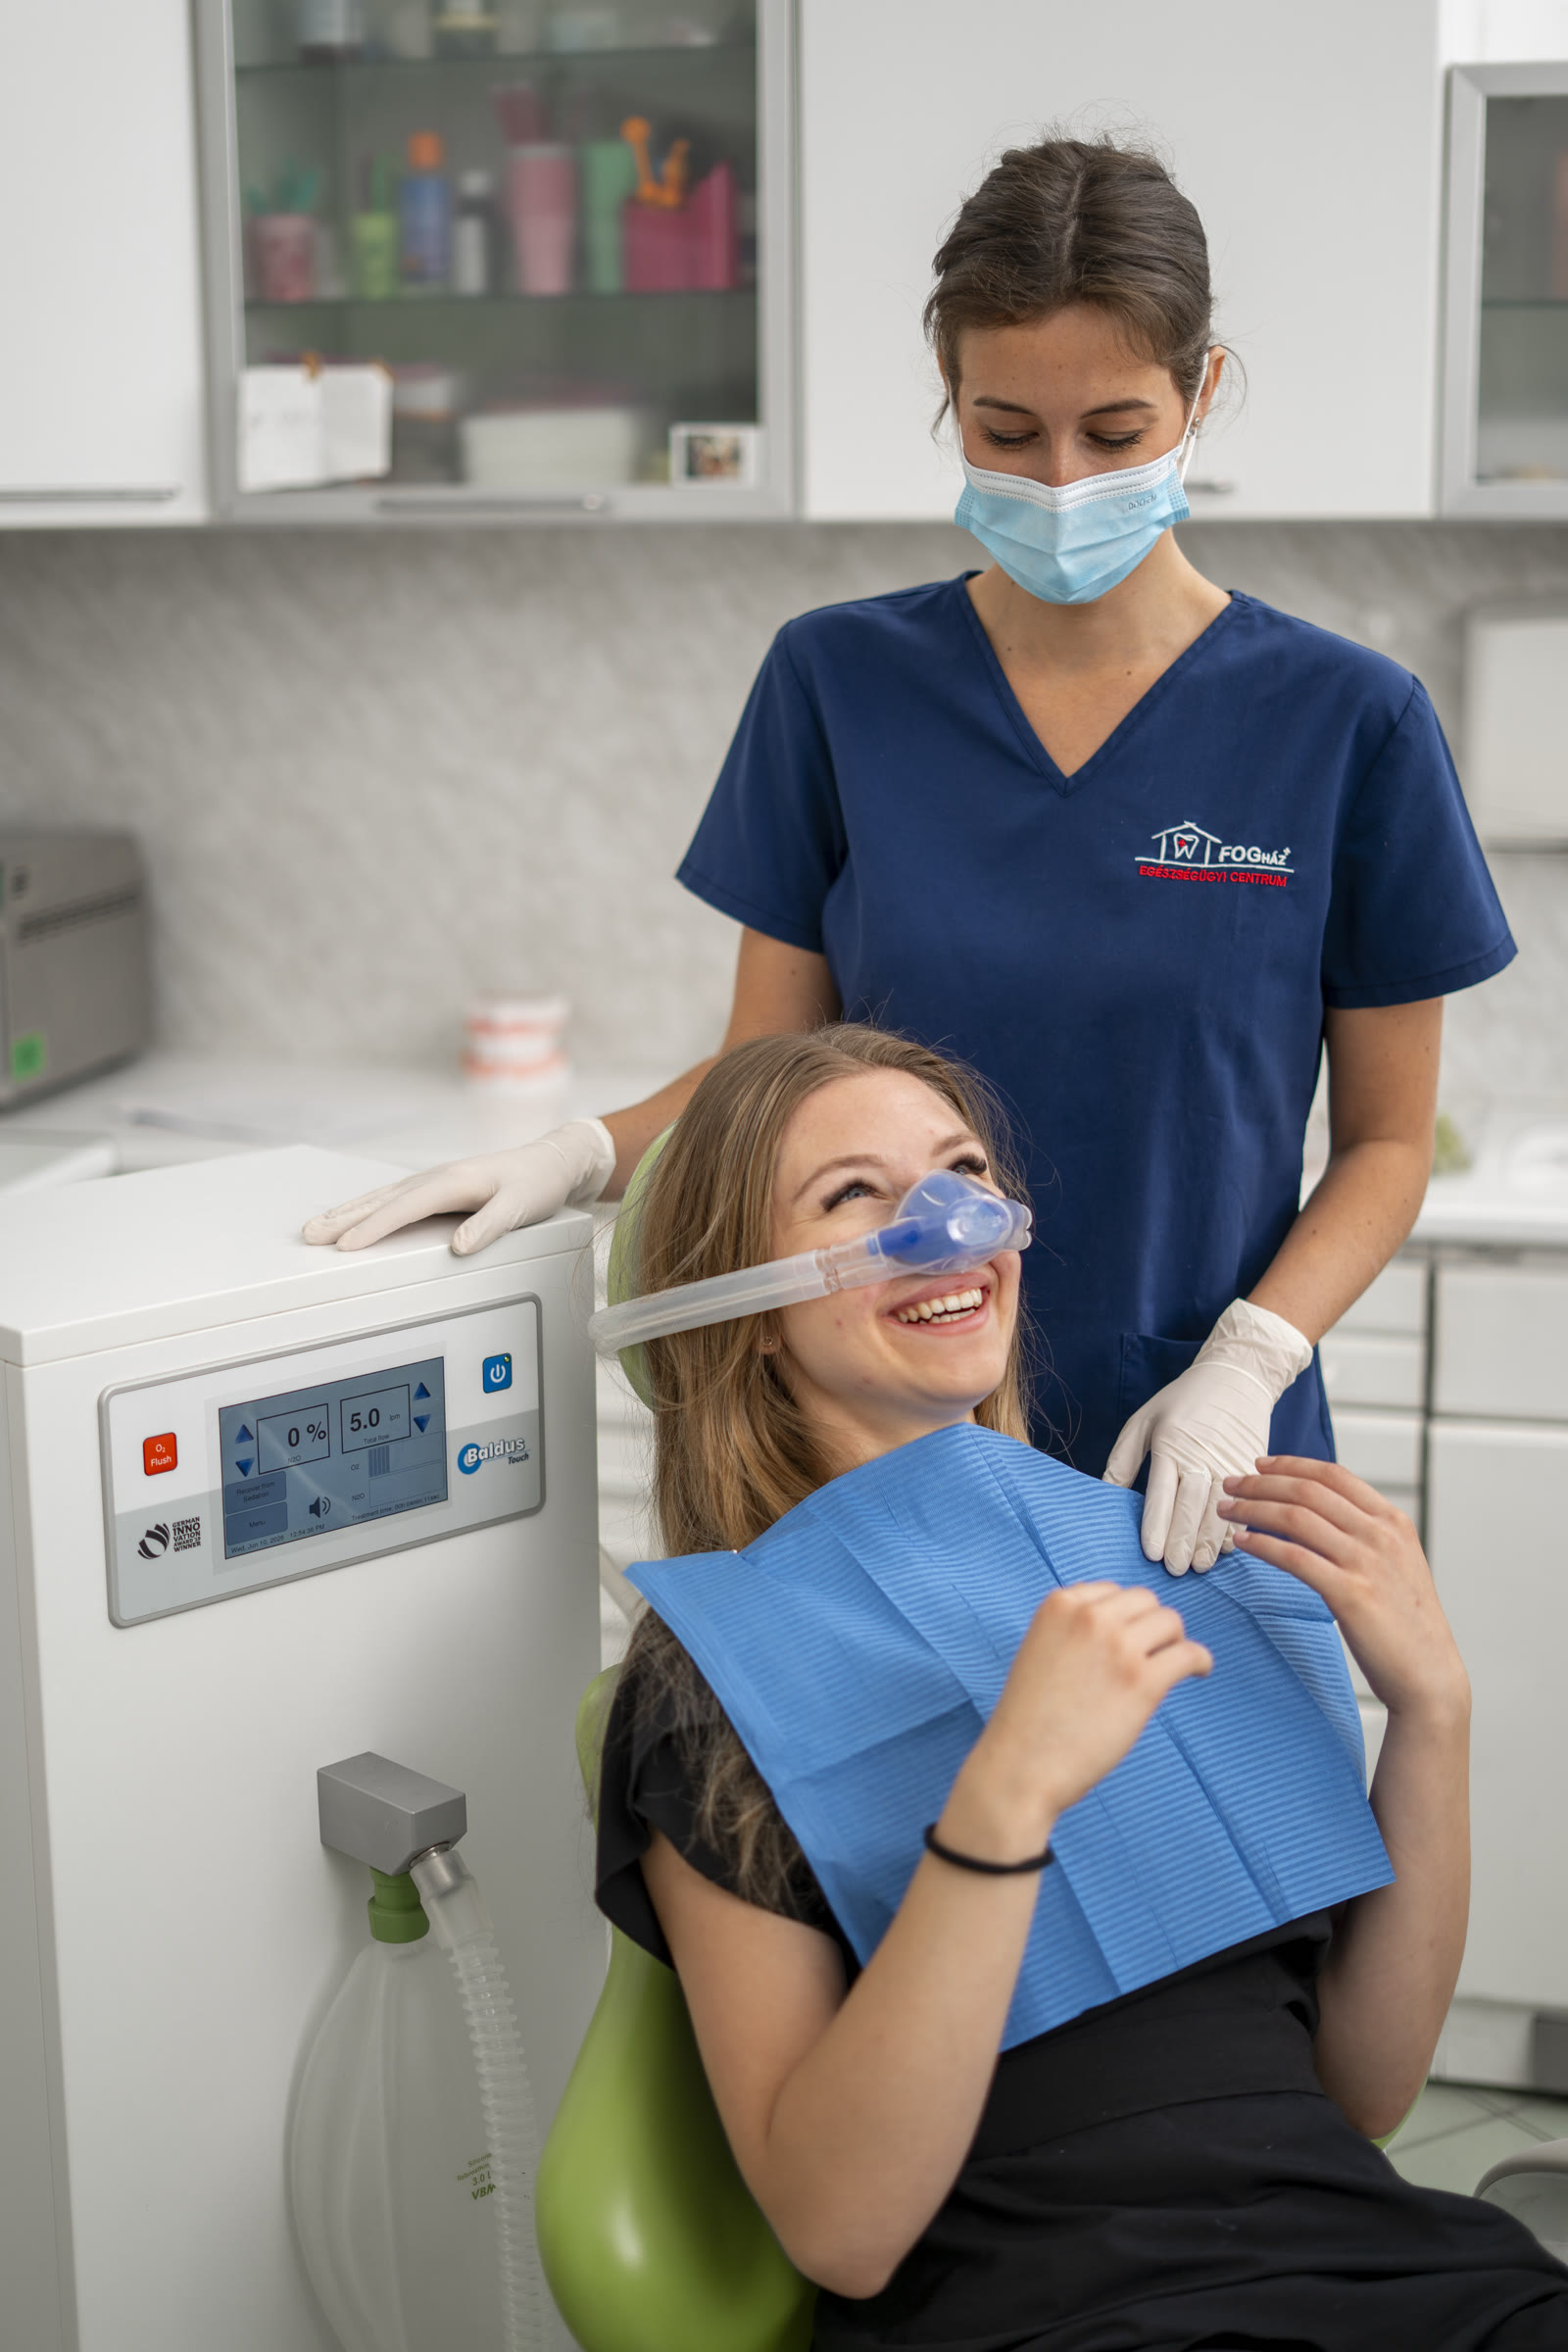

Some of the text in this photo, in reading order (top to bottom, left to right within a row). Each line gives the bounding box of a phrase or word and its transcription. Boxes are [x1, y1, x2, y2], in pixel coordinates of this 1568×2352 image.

[1138, 864, 1288, 887] EGÉSZSÉGÜGYI CENTRUM
[350, 1407, 380, 1432] 5.0
[287, 1421, 327, 1447] 0 %
[363, 1436, 377, 1446] Total
[466, 1438, 526, 1464] Baldus
[150, 1454, 172, 1467] Flush
[507, 1451, 530, 1465] Touch
[172, 1515, 201, 1528] GERMAN
[249, 1519, 267, 1529] Menu
[172, 1522, 201, 1537] INNO
[172, 1530, 201, 1543] VATION
[172, 1541, 202, 1553] WINNER
[472, 2173, 485, 2186] 3.0
